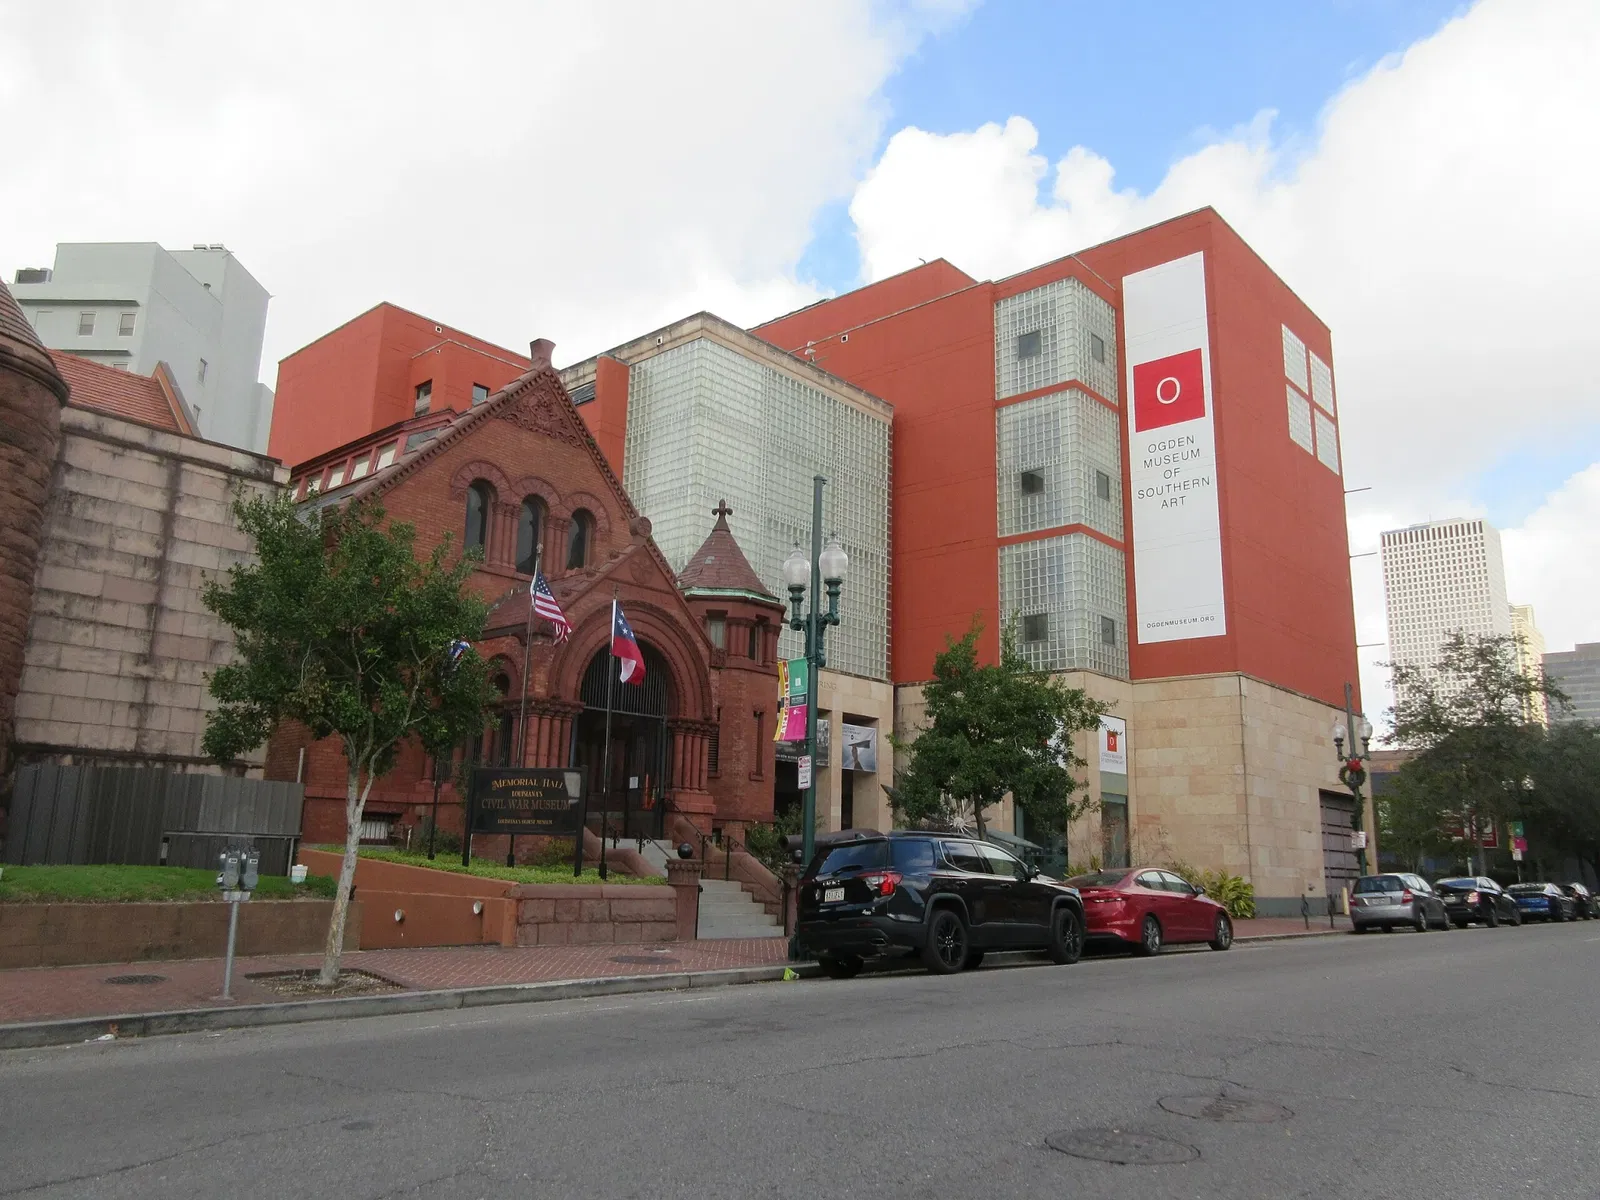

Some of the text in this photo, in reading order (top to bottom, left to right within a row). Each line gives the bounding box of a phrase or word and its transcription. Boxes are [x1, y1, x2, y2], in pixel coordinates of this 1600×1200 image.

[1156, 376, 1181, 405] O
[1147, 435, 1195, 455] OGDEN
[1143, 448, 1200, 469] MUSEUM
[1163, 467, 1181, 480] OF
[1137, 476, 1210, 500] SOUTHERN
[1161, 495, 1187, 510] ART
[1146, 615, 1215, 629] OGDENMUSEUM.ORG
[492, 778, 564, 790] MEMORIAL HALL
[482, 798, 571, 810] CIVIL WAR MUSEUM
